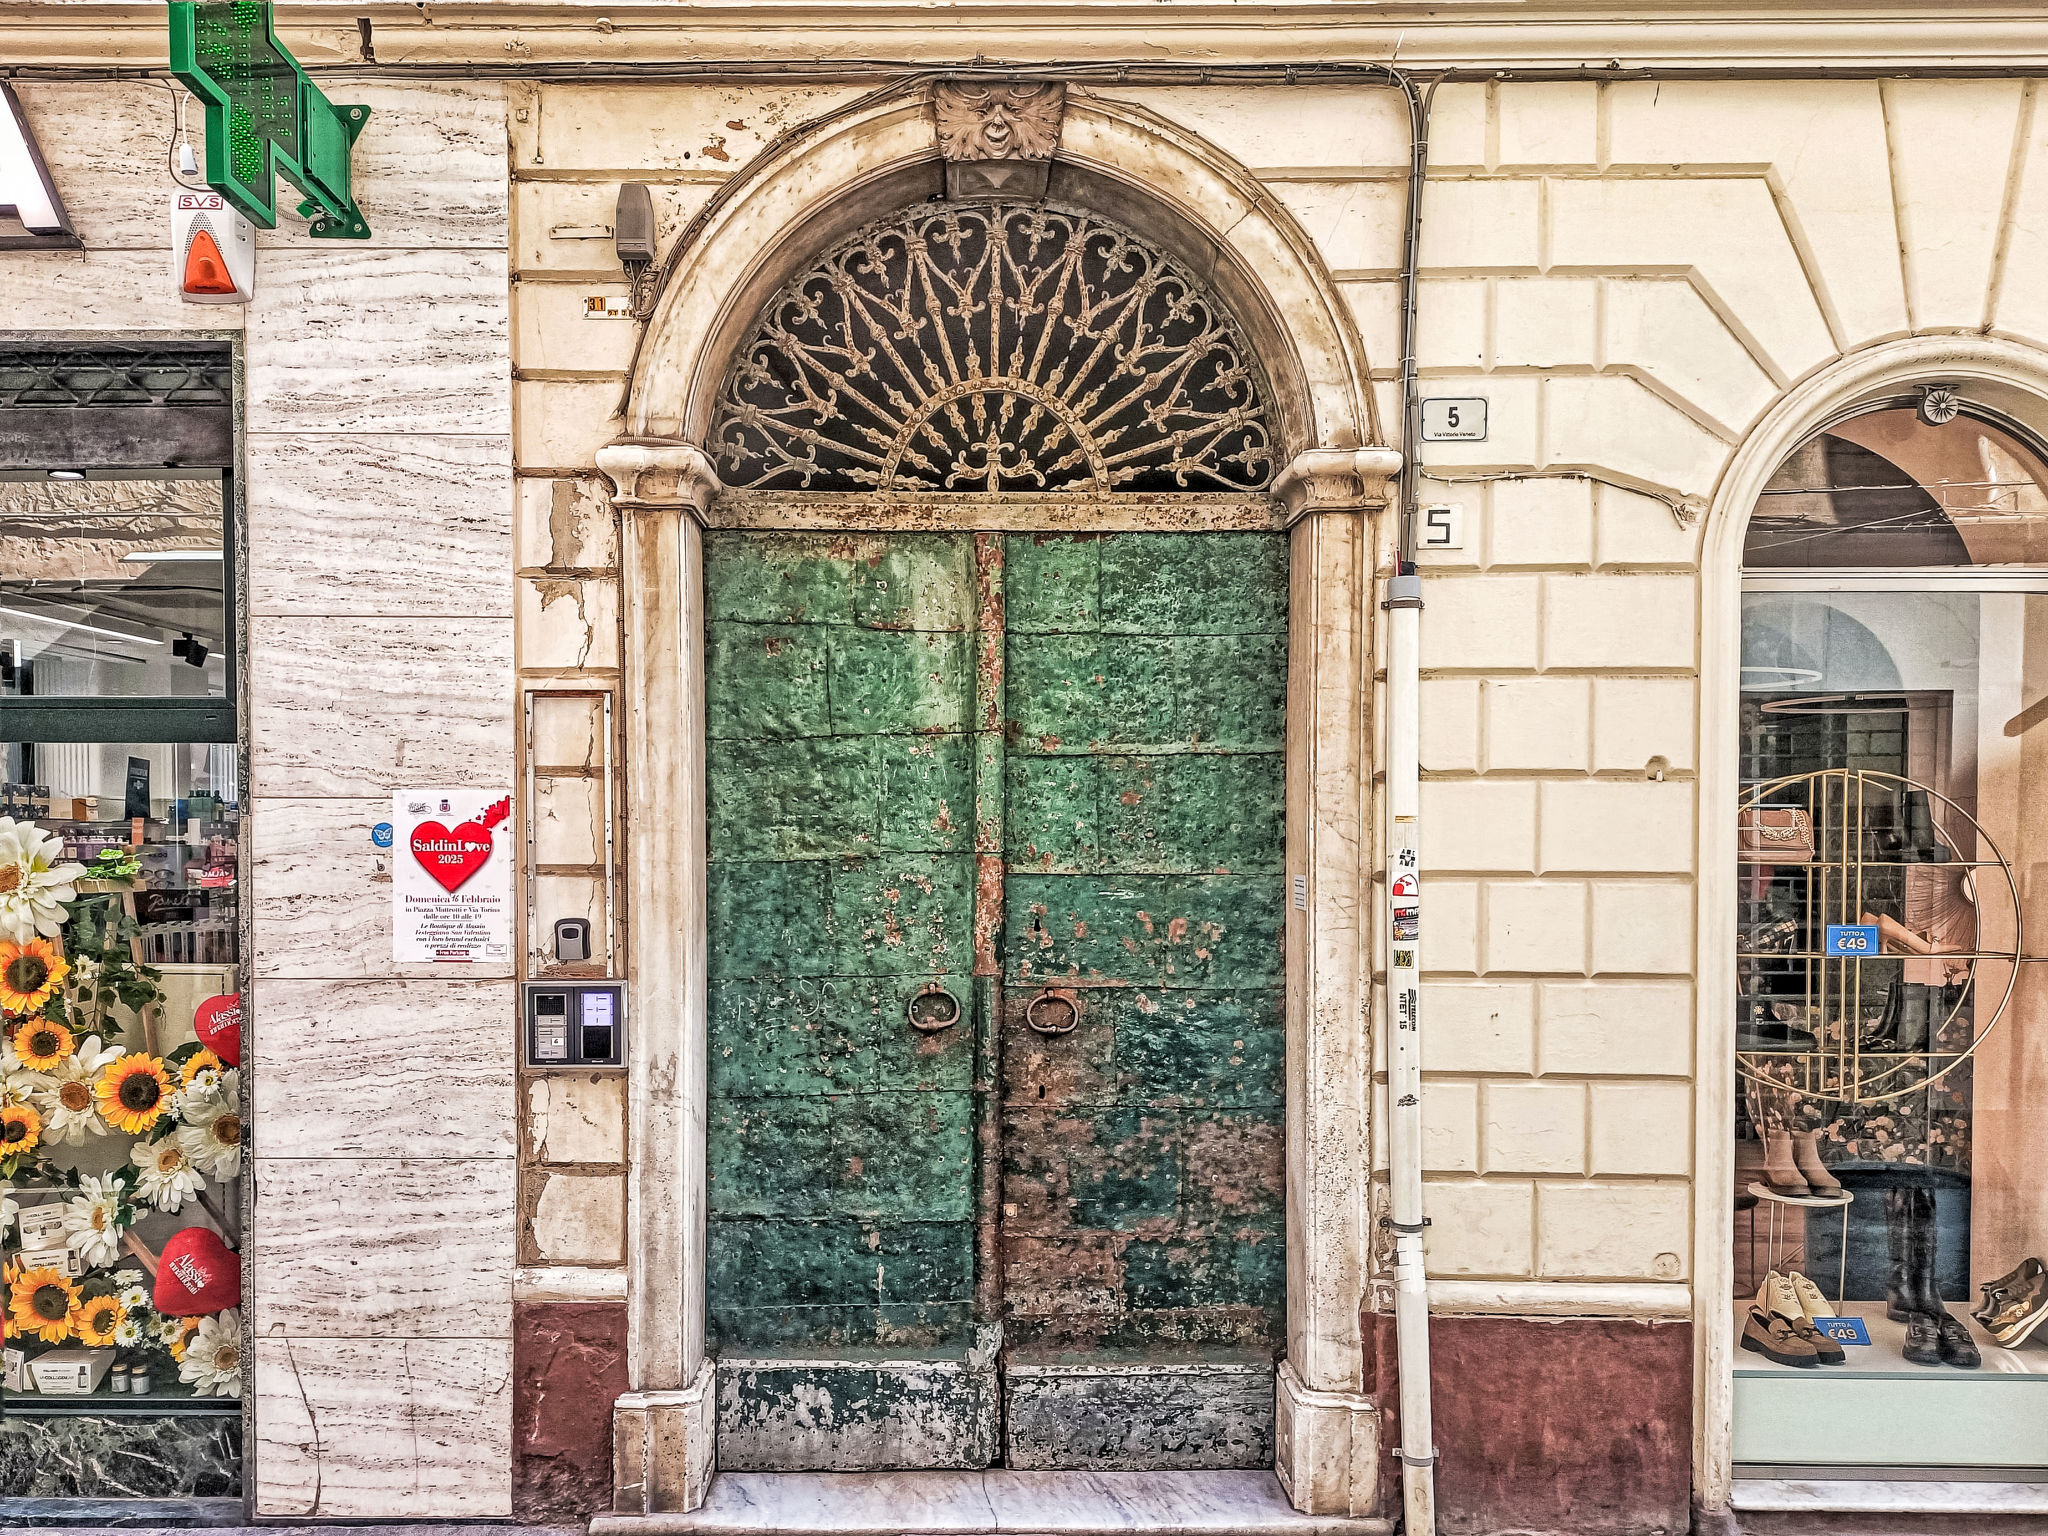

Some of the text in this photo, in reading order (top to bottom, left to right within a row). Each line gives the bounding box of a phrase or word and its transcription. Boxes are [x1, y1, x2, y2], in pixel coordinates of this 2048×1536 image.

[182, 195, 220, 208] SVS
[589, 298, 604, 310] 31
[1448, 406, 1460, 428] 5
[1427, 509, 1451, 544] 5
[438, 855, 463, 864] 2025
[406, 895, 450, 903] Domenica
[462, 895, 500, 903] Febbraio
[1837, 938, 1867, 950] €49
[1400, 1020, 1407, 1030] 15
[1828, 1328, 1857, 1340] €49
